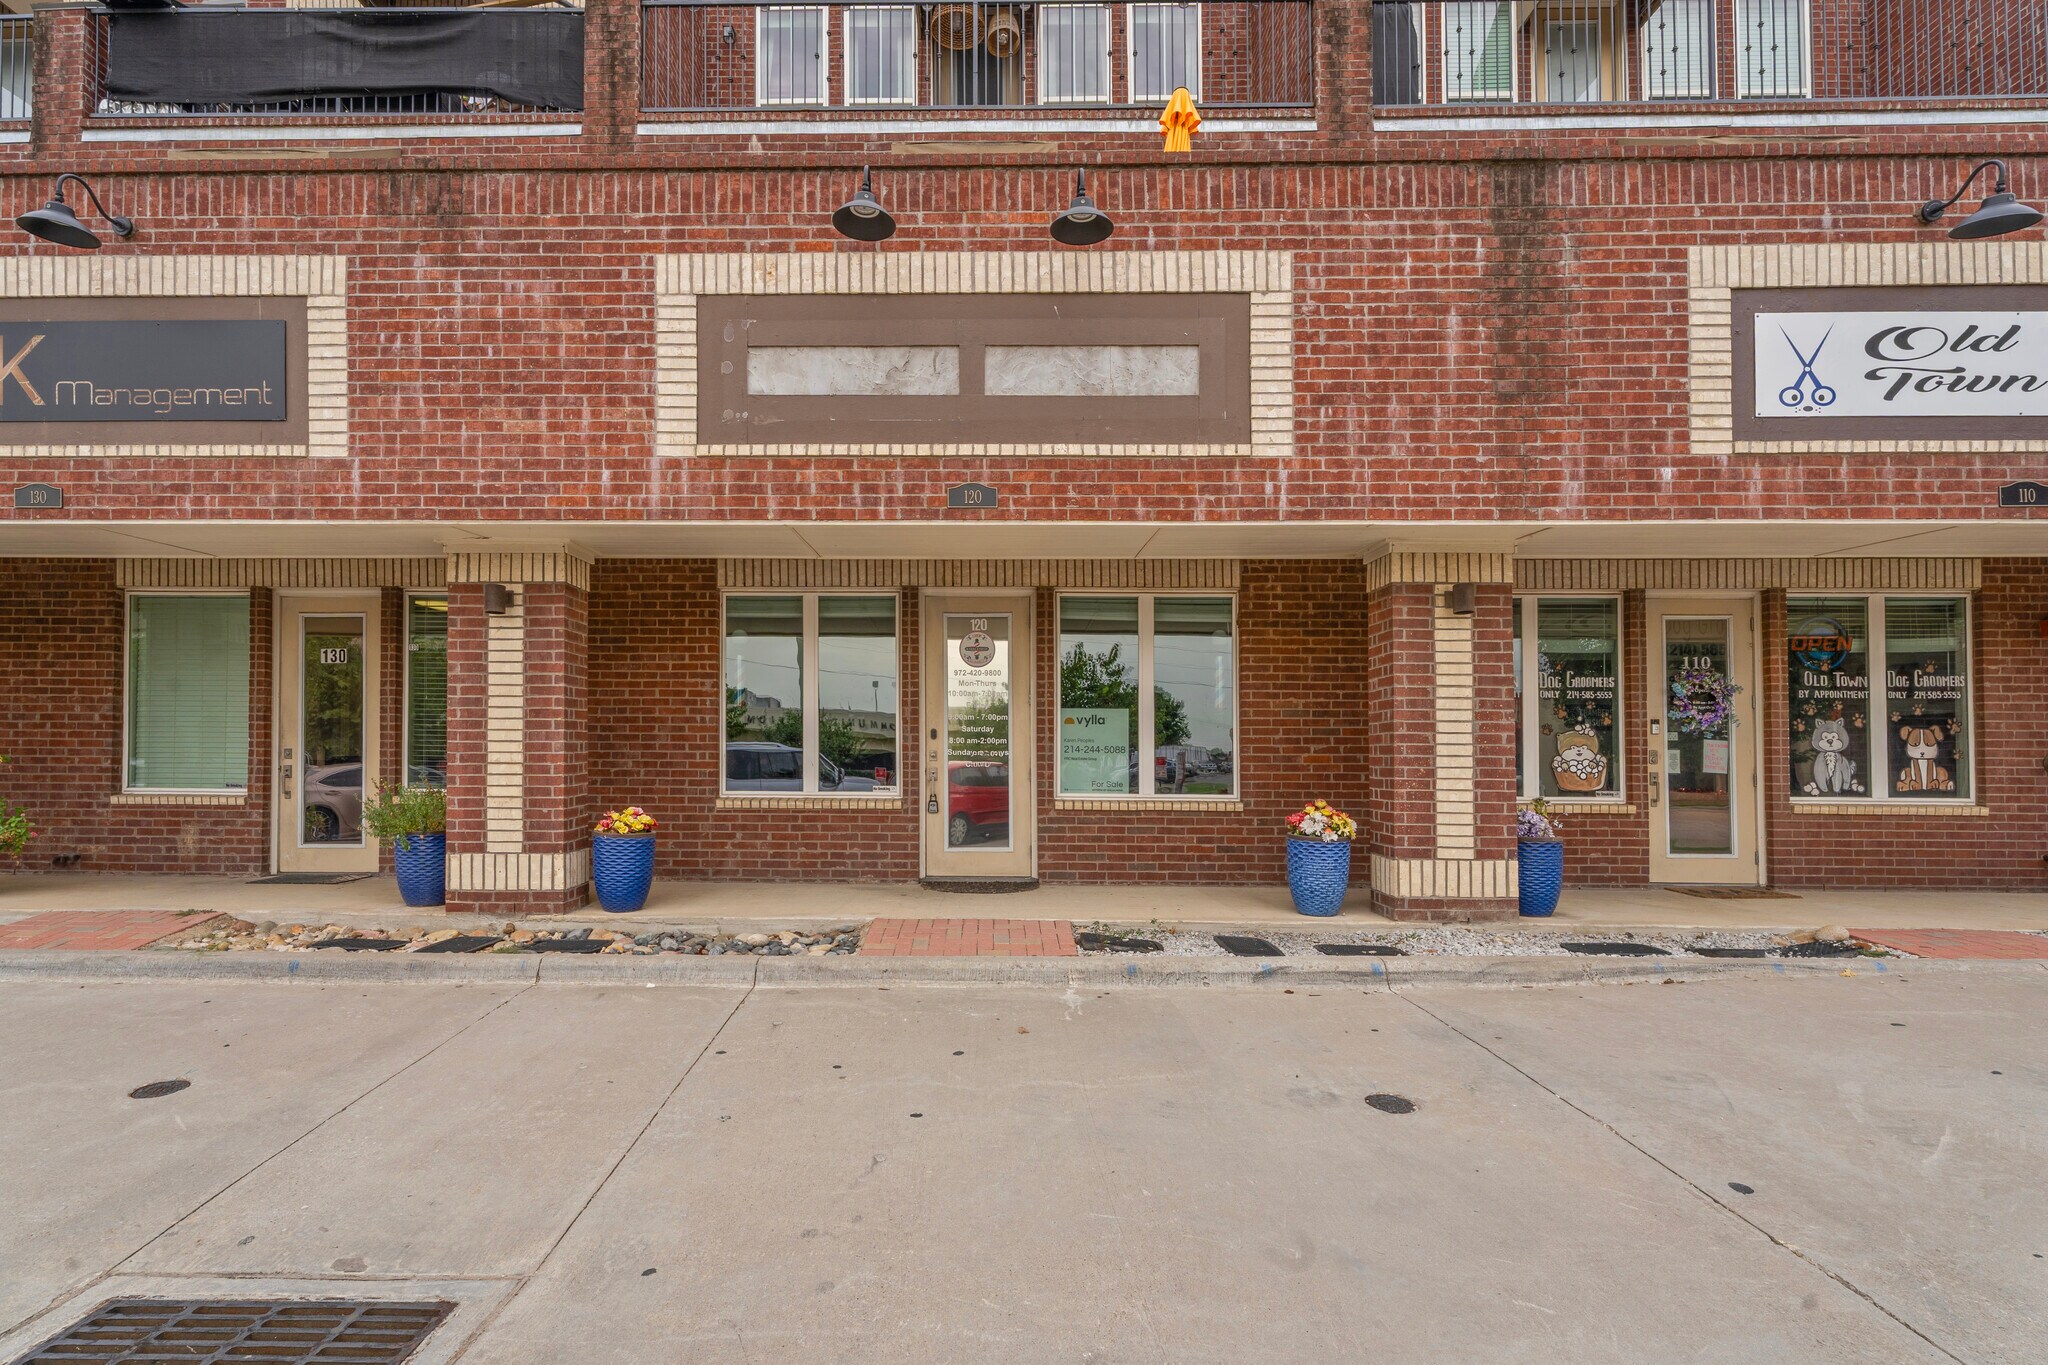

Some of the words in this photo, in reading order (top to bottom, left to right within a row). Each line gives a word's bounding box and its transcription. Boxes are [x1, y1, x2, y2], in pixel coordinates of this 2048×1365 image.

[1864, 325, 2021, 362] Old
[1864, 366, 2048, 401] Town
[55, 380, 273, 414] Management
[29, 490, 47, 504] 130
[964, 490, 982, 504] 120
[2018, 488, 2036, 503] 110
[970, 618, 988, 631] 120
[1791, 636, 1853, 651] OPEN
[322, 649, 346, 663] 130
[1682, 656, 1711, 669] 110
[953, 669, 1002, 677] 972-420-9800
[1540, 690, 1560, 699] ONLY
[1798, 690, 1809, 698] BY
[1814, 690, 1869, 699] APPOINTMENT
[1887, 690, 1907, 699] ONLY
[980, 713, 1008, 722] 7:00pm
[1076, 714, 1105, 727] vylla
[961, 725, 994, 734] Saturday
[966, 737, 1007, 745] am-2:00pm
[1063, 745, 1126, 754] 214-244-5088
[1091, 780, 1104, 788] For
[1106, 780, 1124, 788] Sale
